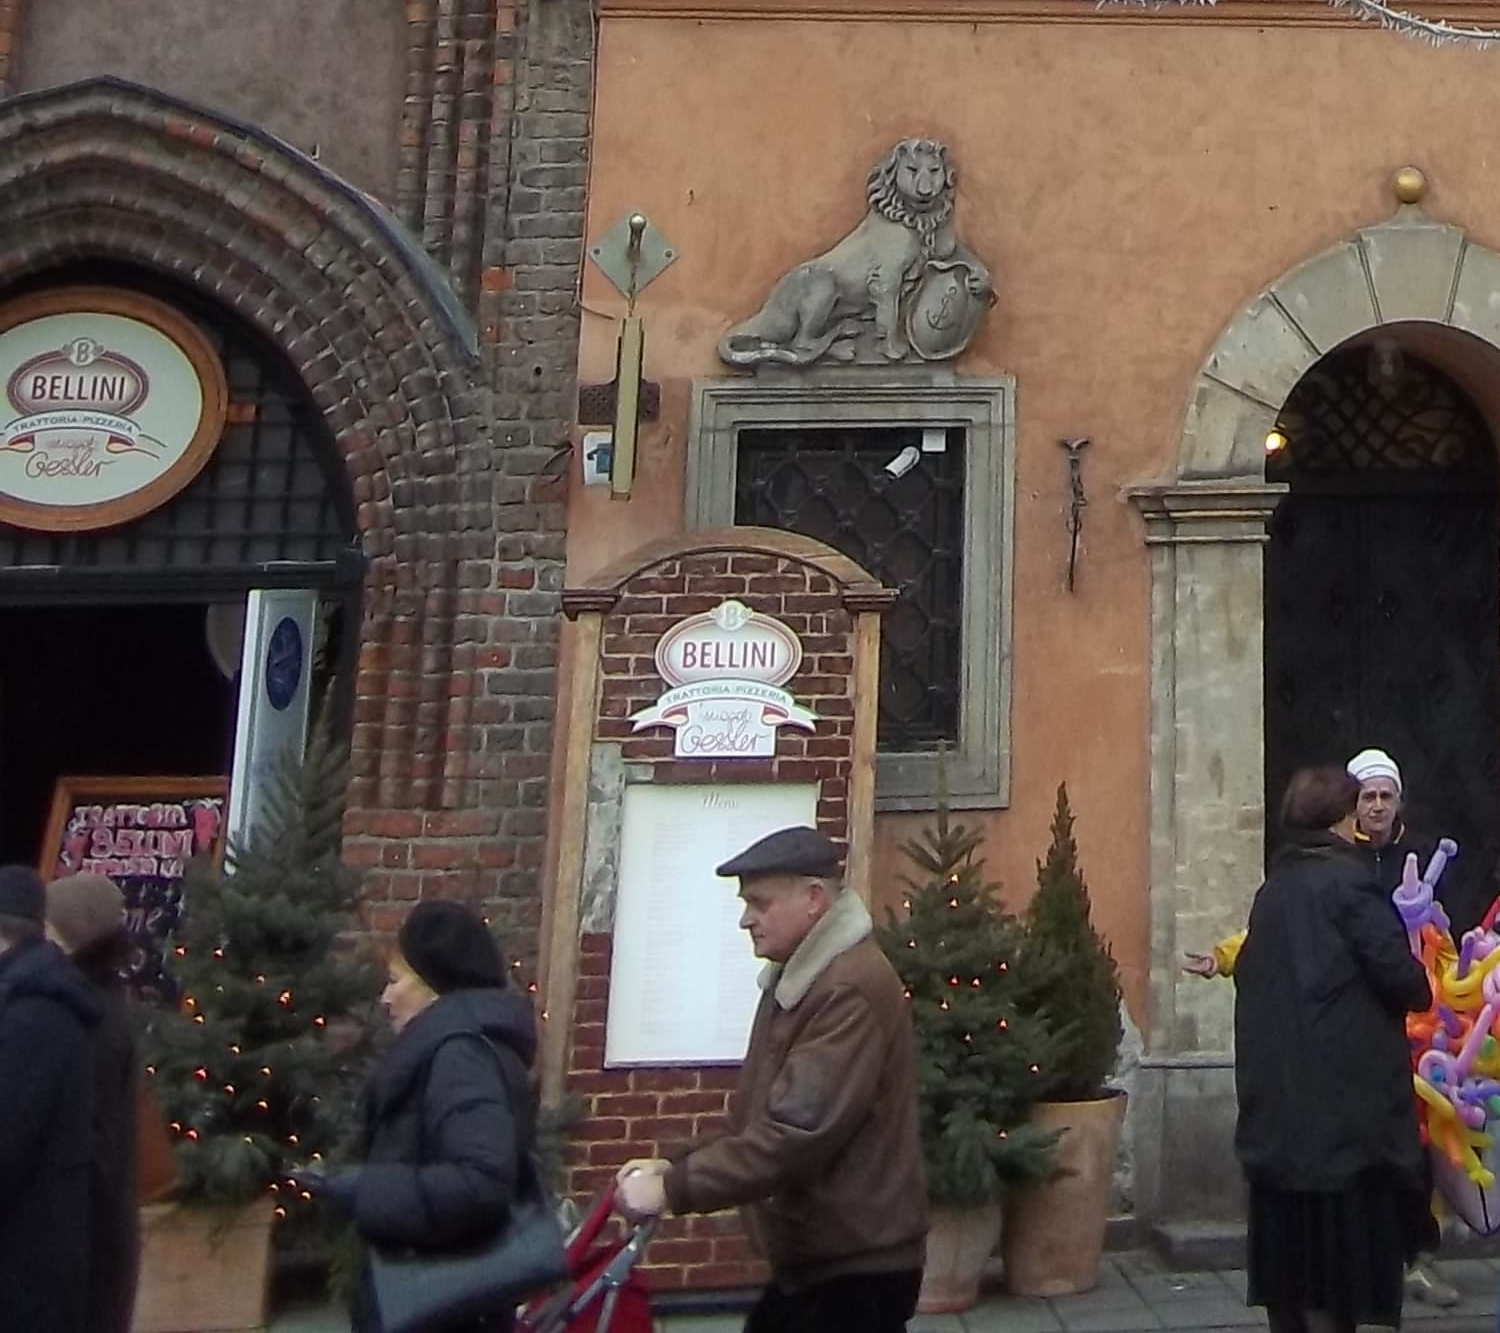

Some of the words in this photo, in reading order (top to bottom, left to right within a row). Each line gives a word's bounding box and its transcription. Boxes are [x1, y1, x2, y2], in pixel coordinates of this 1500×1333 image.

[75, 341, 90, 363] B
[31, 375, 125, 401] BELLINI
[14, 415, 78, 434] TRATTORIA
[83, 416, 134, 434] PIZZERIA
[25, 450, 116, 479] Gessler
[682, 641, 777, 669] BELLINI
[665, 685, 731, 704] TRATTORIA
[735, 685, 788, 704] PIZZERIA
[680, 723, 767, 754] Gessler
